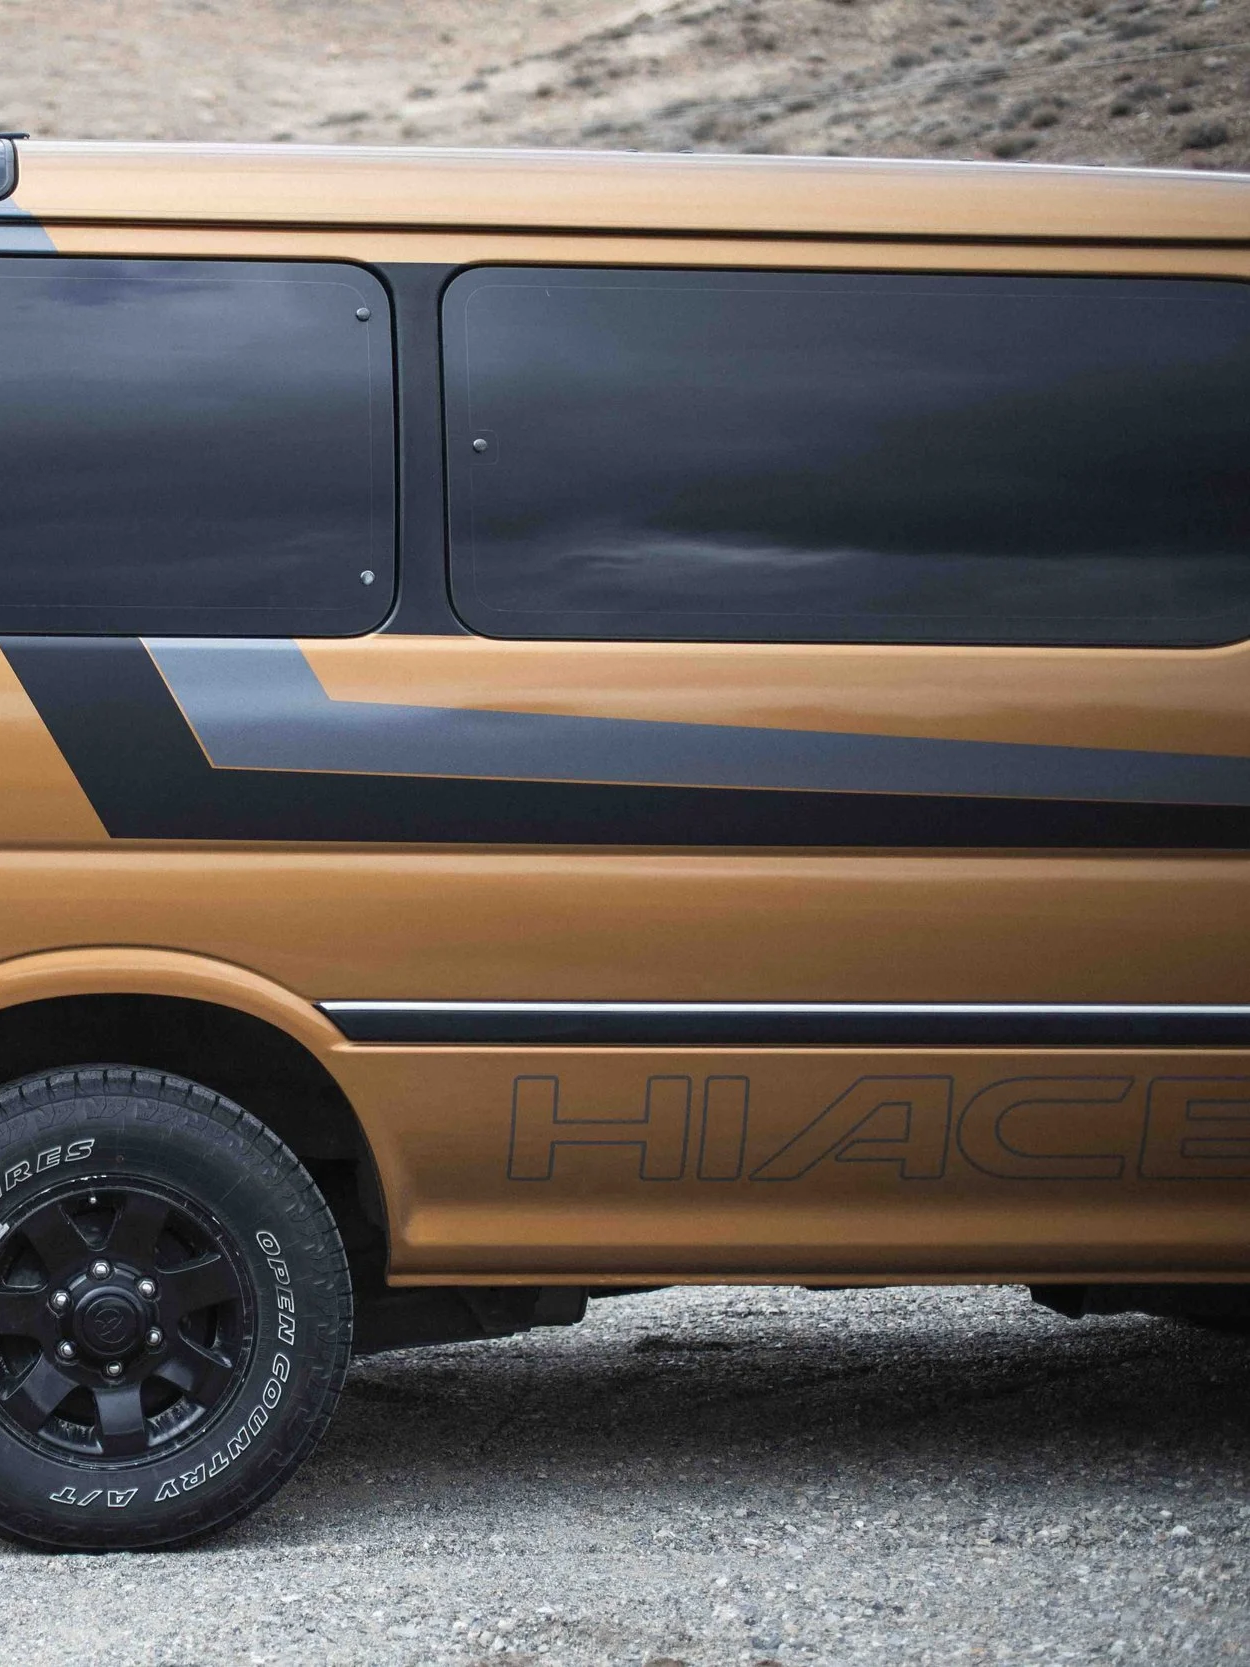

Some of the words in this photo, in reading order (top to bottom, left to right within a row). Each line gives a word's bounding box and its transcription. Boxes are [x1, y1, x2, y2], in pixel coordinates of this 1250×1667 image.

[507, 1074, 1250, 1181] HIACE
[256, 1230, 296, 1345] OPEN
[155, 1353, 291, 1502] COUNTRY
[50, 1486, 138, 1507] A/T
